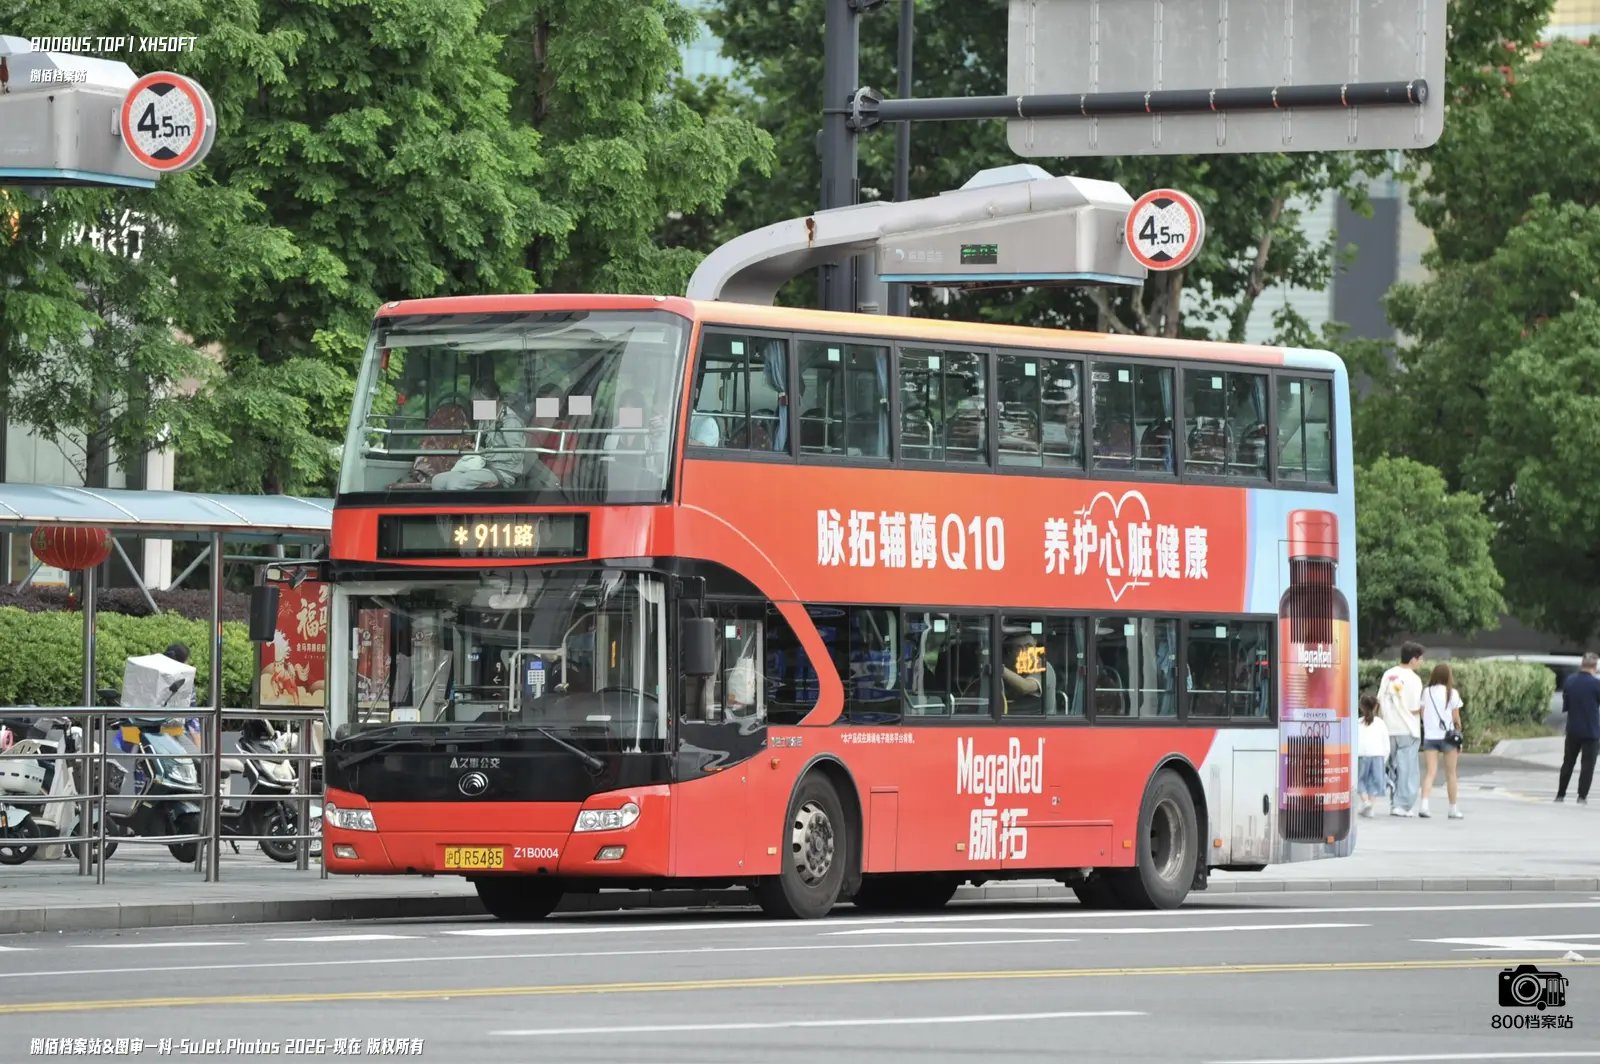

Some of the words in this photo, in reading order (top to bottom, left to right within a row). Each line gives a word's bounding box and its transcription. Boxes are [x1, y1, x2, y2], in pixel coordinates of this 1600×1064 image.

[137, 102, 191, 139] 4.5m
[1139, 215, 1185, 246] 4.5m
[475, 523, 534, 548] 911路
[816, 509, 1006, 571] 脉拓辅酶Q10
[1043, 517, 1209, 580] 养护心脏健康
[1297, 643, 1332, 673] MegaRed
[957, 737, 1044, 806] MegaRed
[513, 847, 560, 859] Z1B0004
[968, 808, 1029, 861] 脉拓
